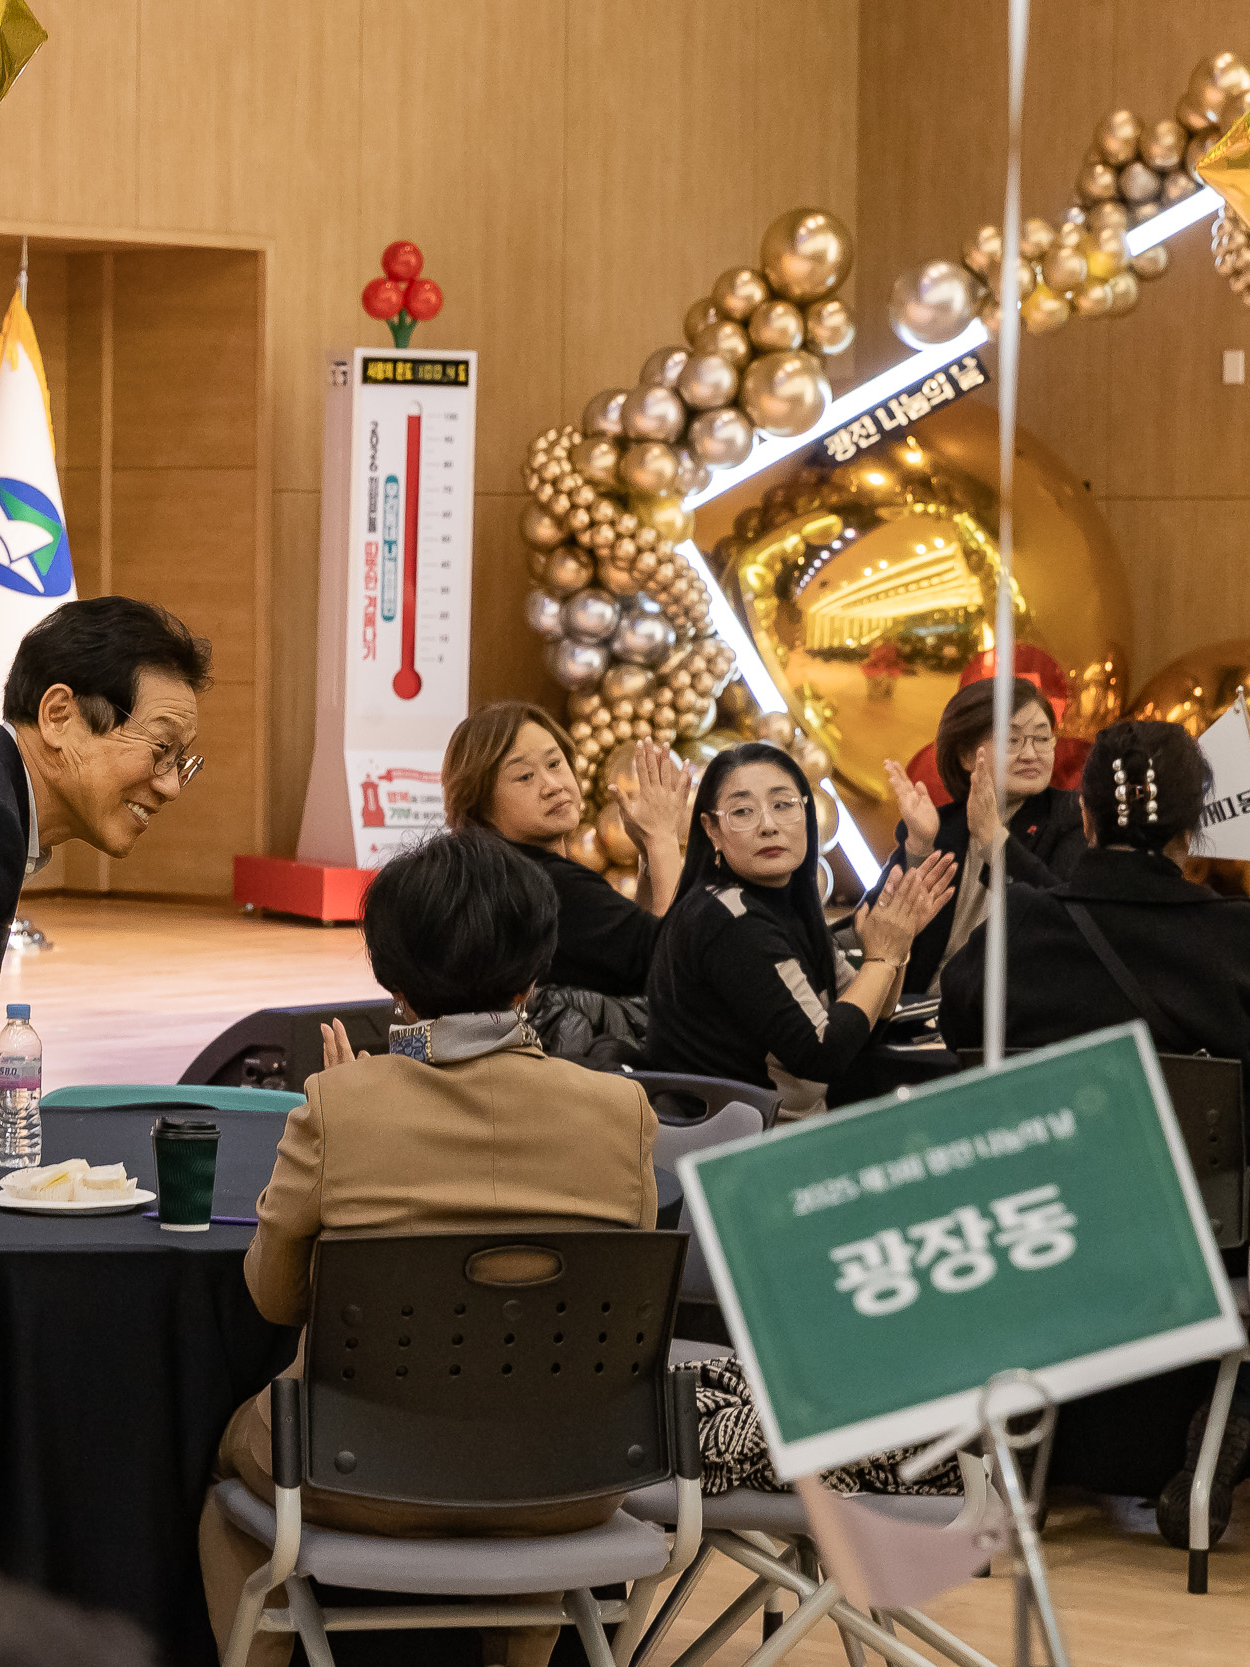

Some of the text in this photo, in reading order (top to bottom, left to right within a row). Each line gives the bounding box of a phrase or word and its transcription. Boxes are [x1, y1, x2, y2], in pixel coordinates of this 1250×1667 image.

[823, 355, 985, 462] 광진 나눔의 날
[829, 1183, 1079, 1317] 광장동
